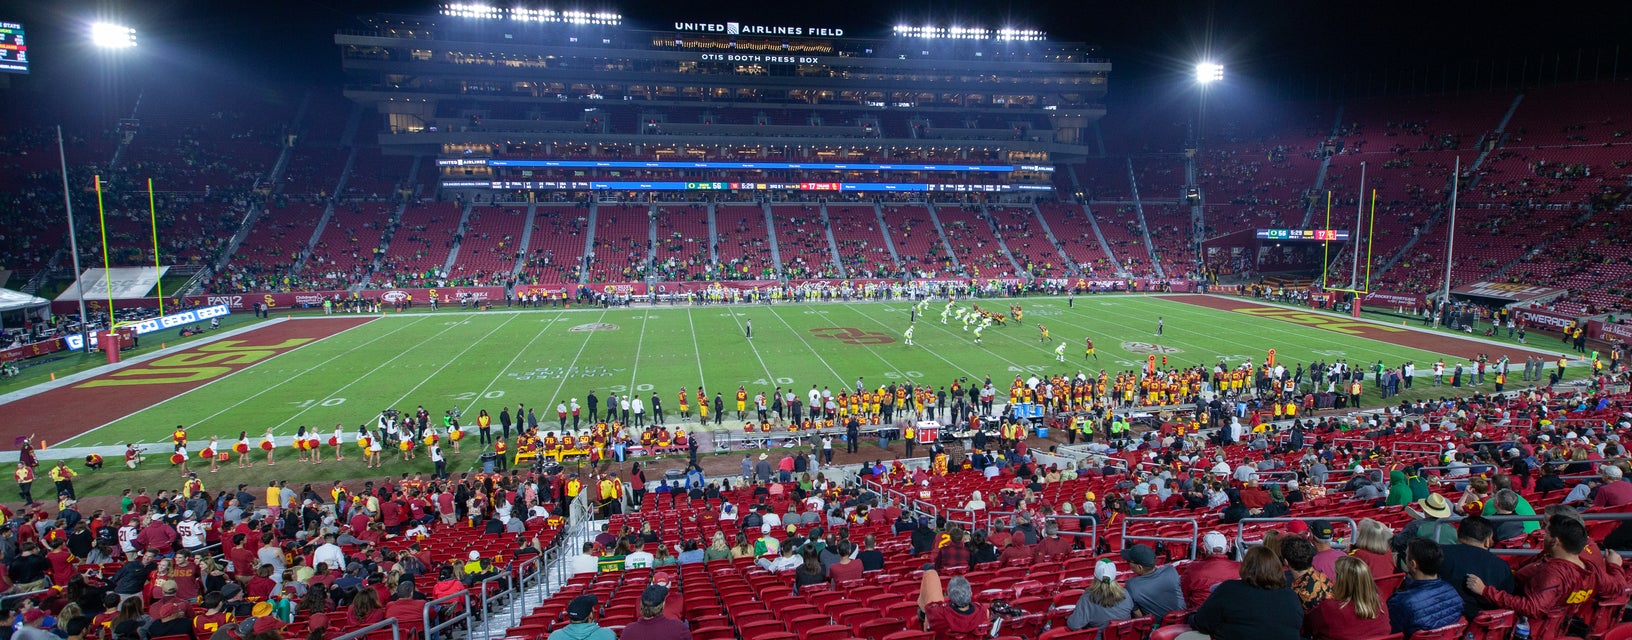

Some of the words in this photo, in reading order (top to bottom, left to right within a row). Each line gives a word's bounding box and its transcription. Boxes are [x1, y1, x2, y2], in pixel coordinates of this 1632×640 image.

[675, 22, 724, 32] UNITED
[742, 25, 802, 34] AIRLINES
[809, 28, 844, 36] FIELD
[197, 305, 226, 319] GEICO
[163, 312, 195, 327] GEICO
[72, 337, 316, 388] USC
[119, 530, 127, 541] 21
[180, 526, 191, 536] 55
[938, 534, 951, 549] 2
[174, 569, 192, 577] USC
[1566, 589, 1593, 603] USC
[204, 622, 219, 633] 7
